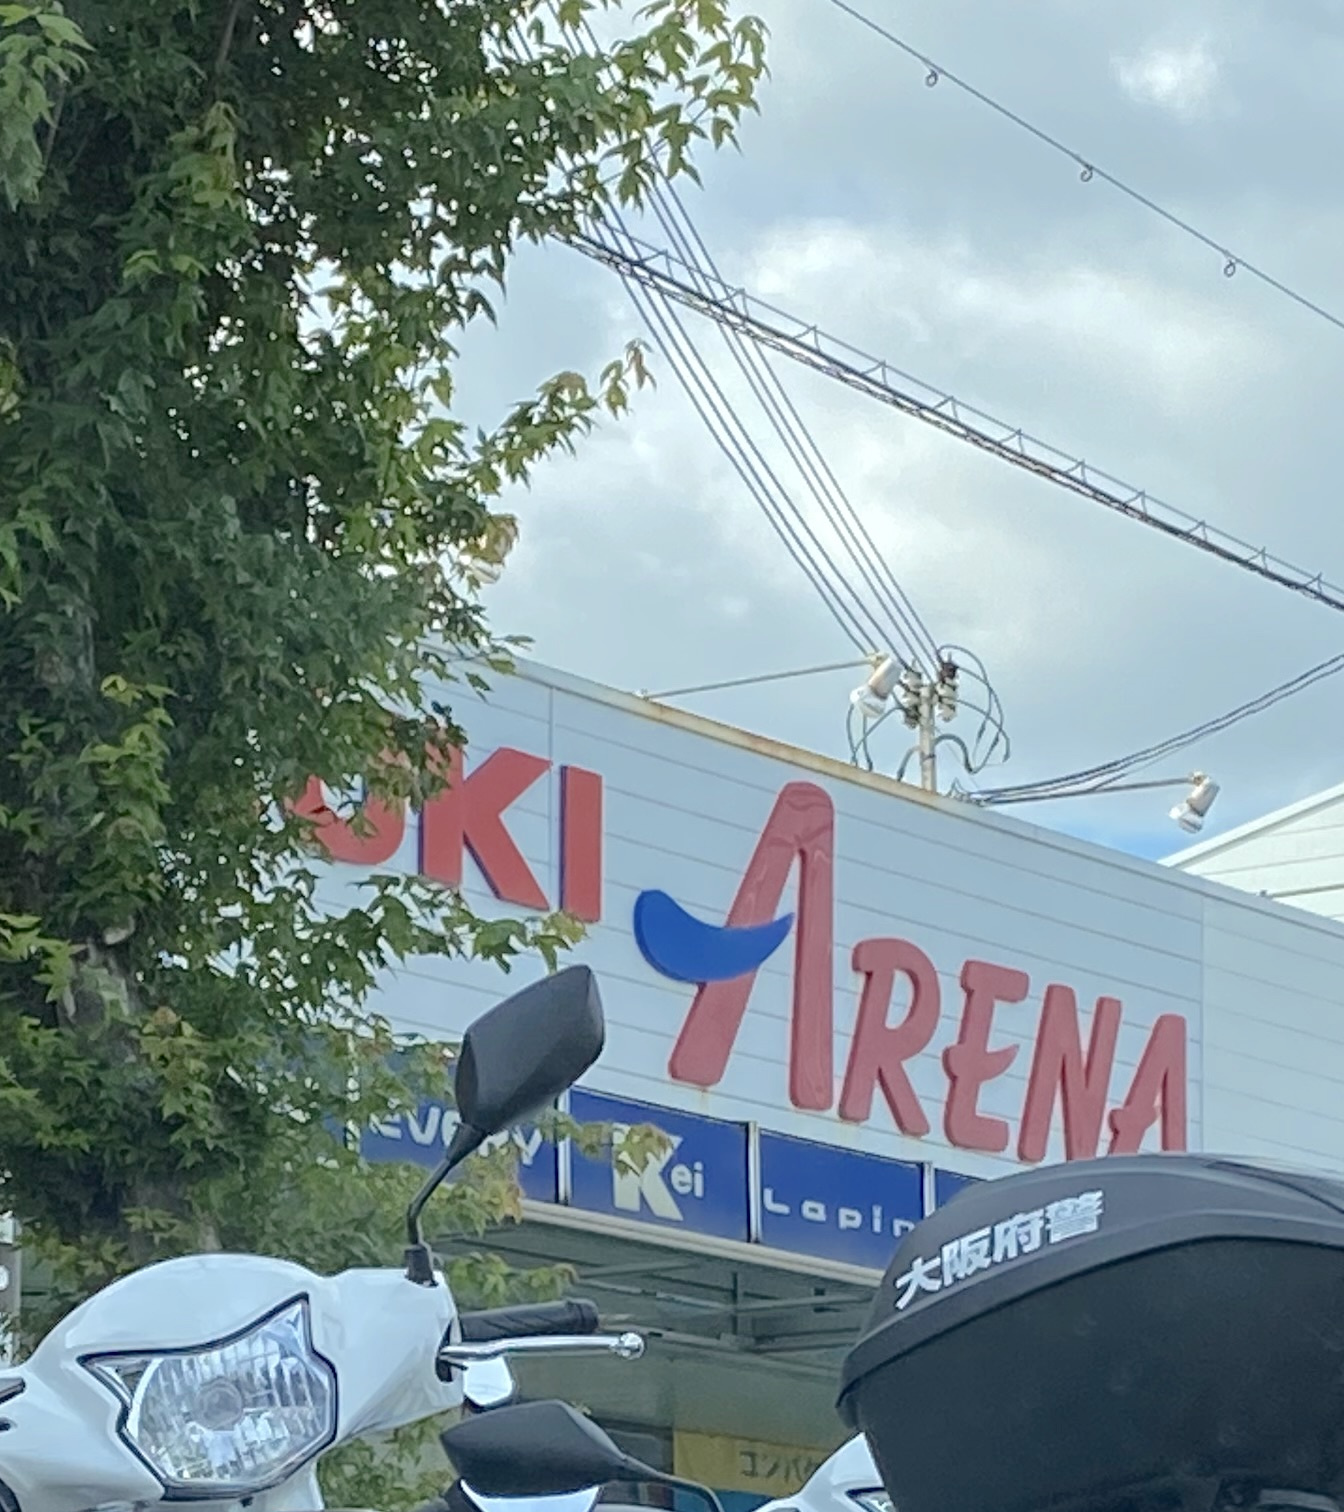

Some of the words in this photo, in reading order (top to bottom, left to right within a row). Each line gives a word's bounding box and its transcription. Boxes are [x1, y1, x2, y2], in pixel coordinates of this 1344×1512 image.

[668, 780, 1188, 1163] ARENA
[612, 1122, 705, 1222] Kei
[894, 1190, 1105, 1310] 大阪府警
